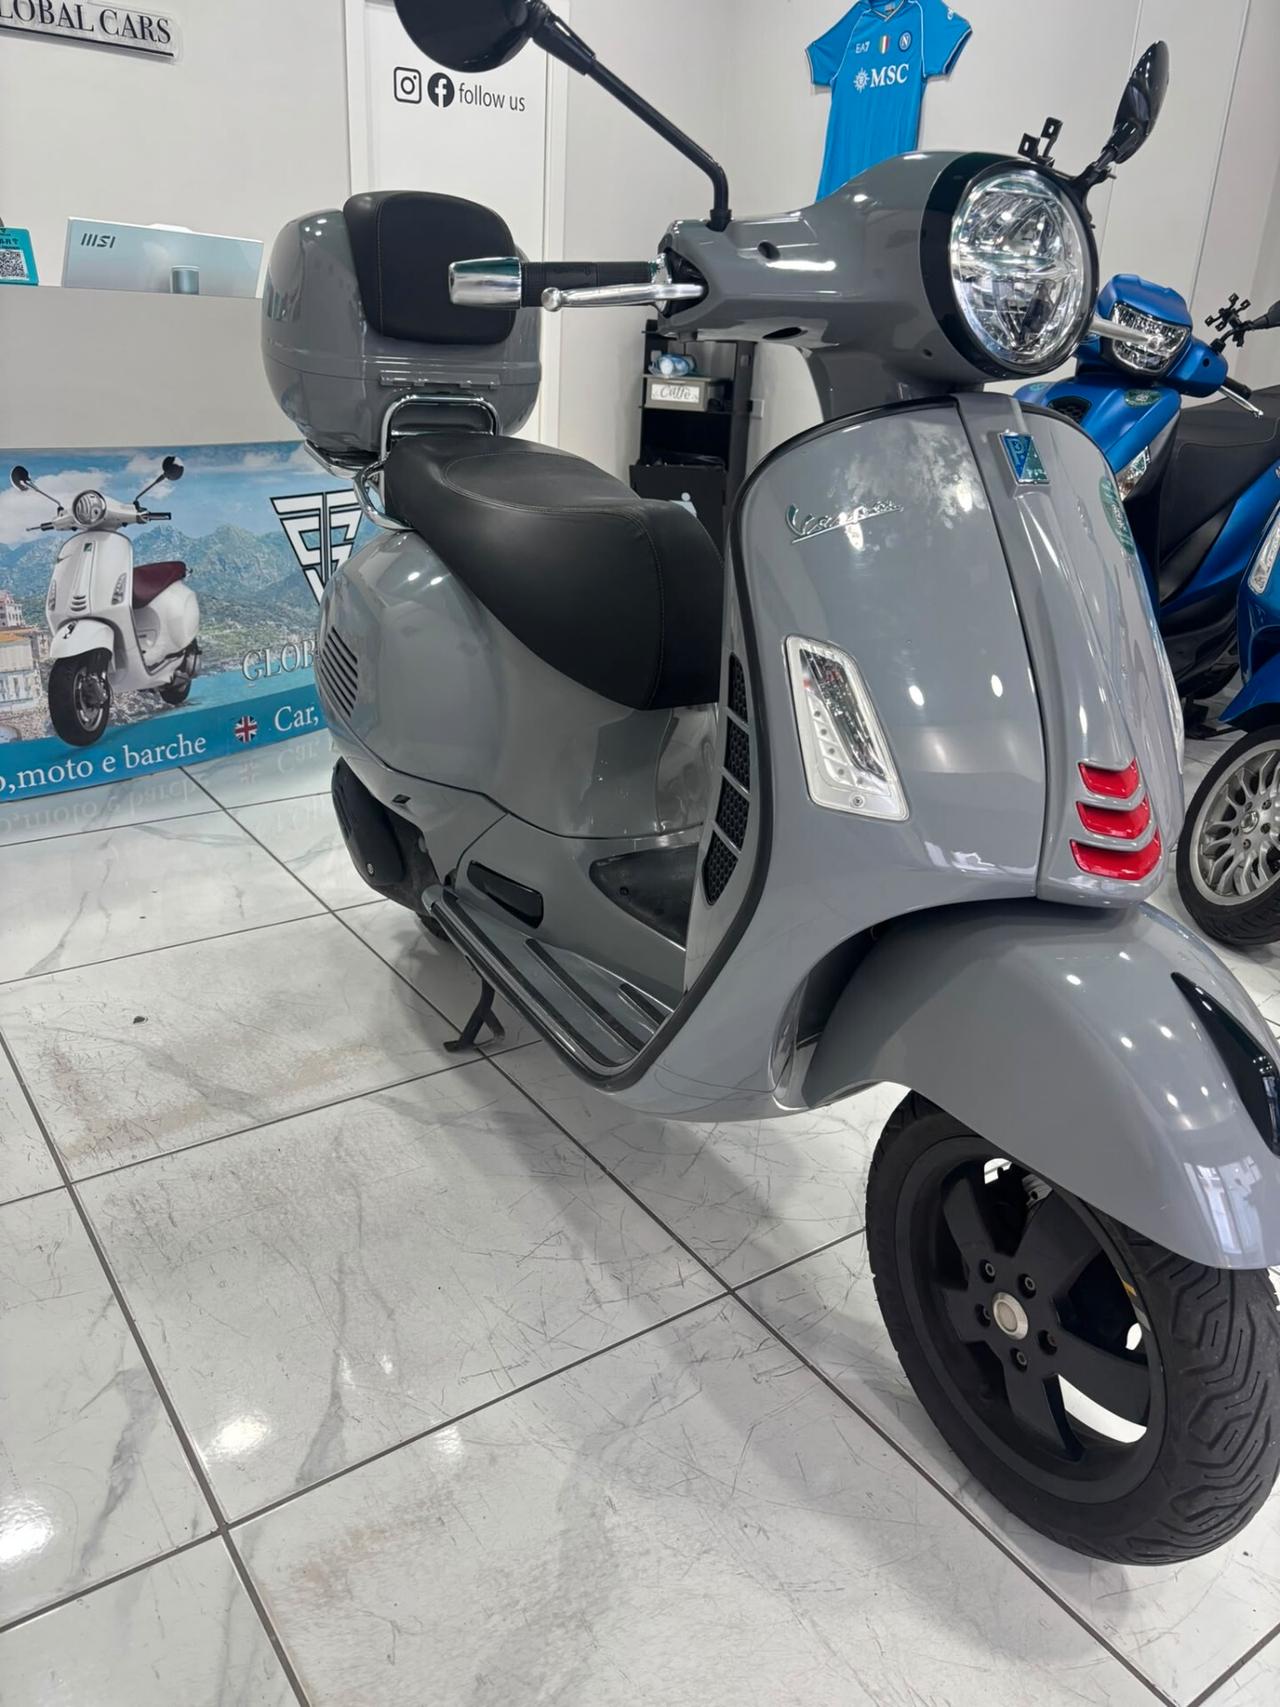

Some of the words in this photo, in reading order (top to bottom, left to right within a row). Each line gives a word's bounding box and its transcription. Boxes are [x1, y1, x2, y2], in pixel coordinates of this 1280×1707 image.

[100, 8, 171, 44] CARS
[855, 41, 870, 54] EA7
[870, 63, 909, 88] MSC
[459, 82, 505, 109] follow
[509, 96, 525, 112] us
[80, 233, 116, 249] MSI
[102, 754, 117, 773] e
[123, 734, 207, 769] barche
[274, 704, 319, 732] Car,
